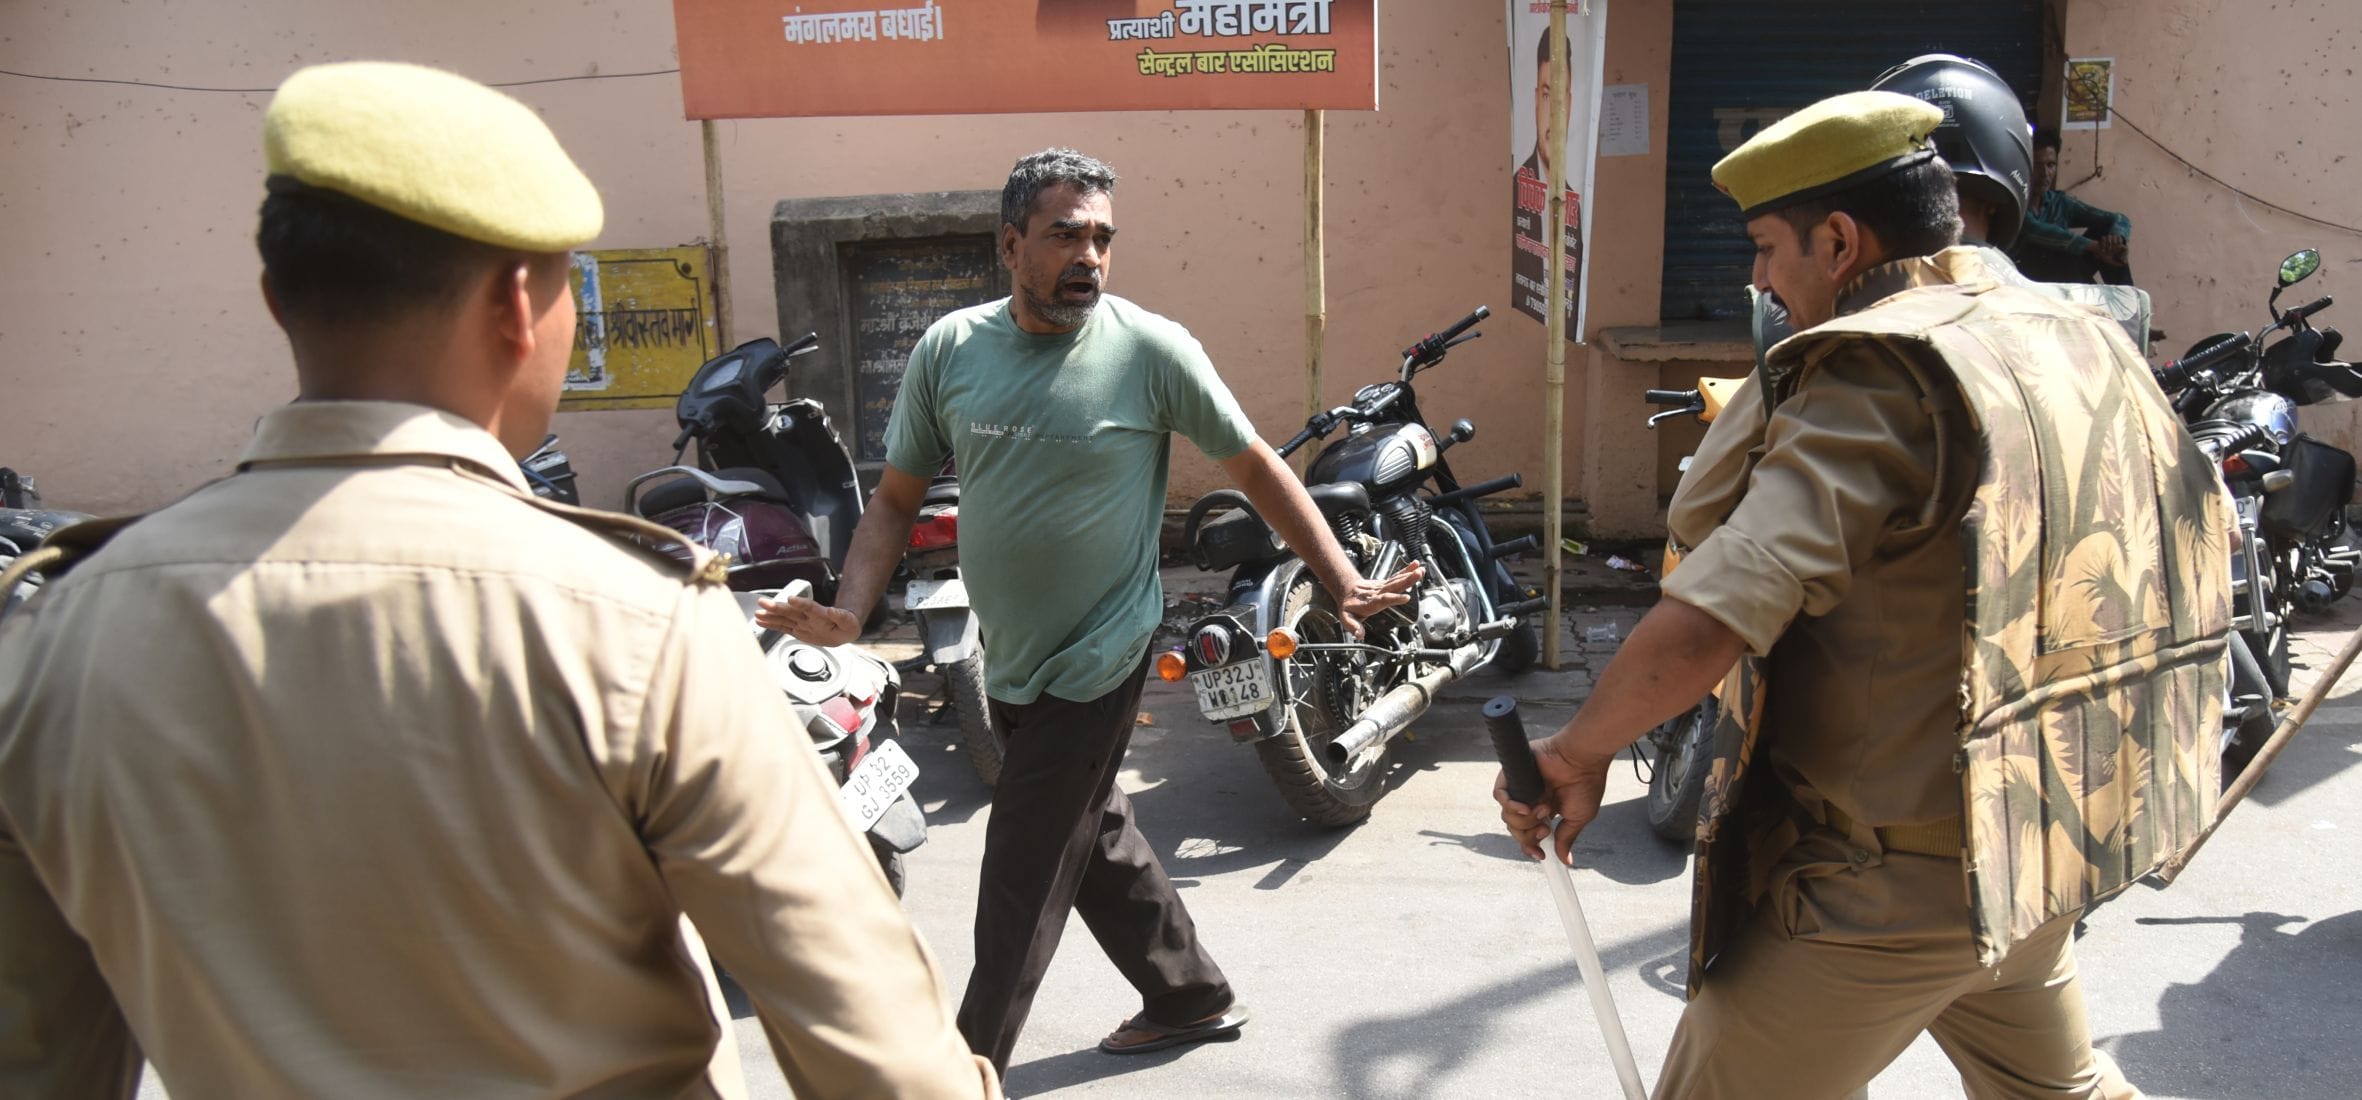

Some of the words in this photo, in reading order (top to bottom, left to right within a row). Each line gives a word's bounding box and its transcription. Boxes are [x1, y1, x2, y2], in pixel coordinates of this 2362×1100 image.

[782, 6, 877, 44] मंगलमय
[1107, 10, 1175, 40] प्रत्याशी
[1194, 52, 1227, 74] बार
[1228, 43, 1336, 74] एसोसिएशन
[878, 764, 911, 799] 3559
